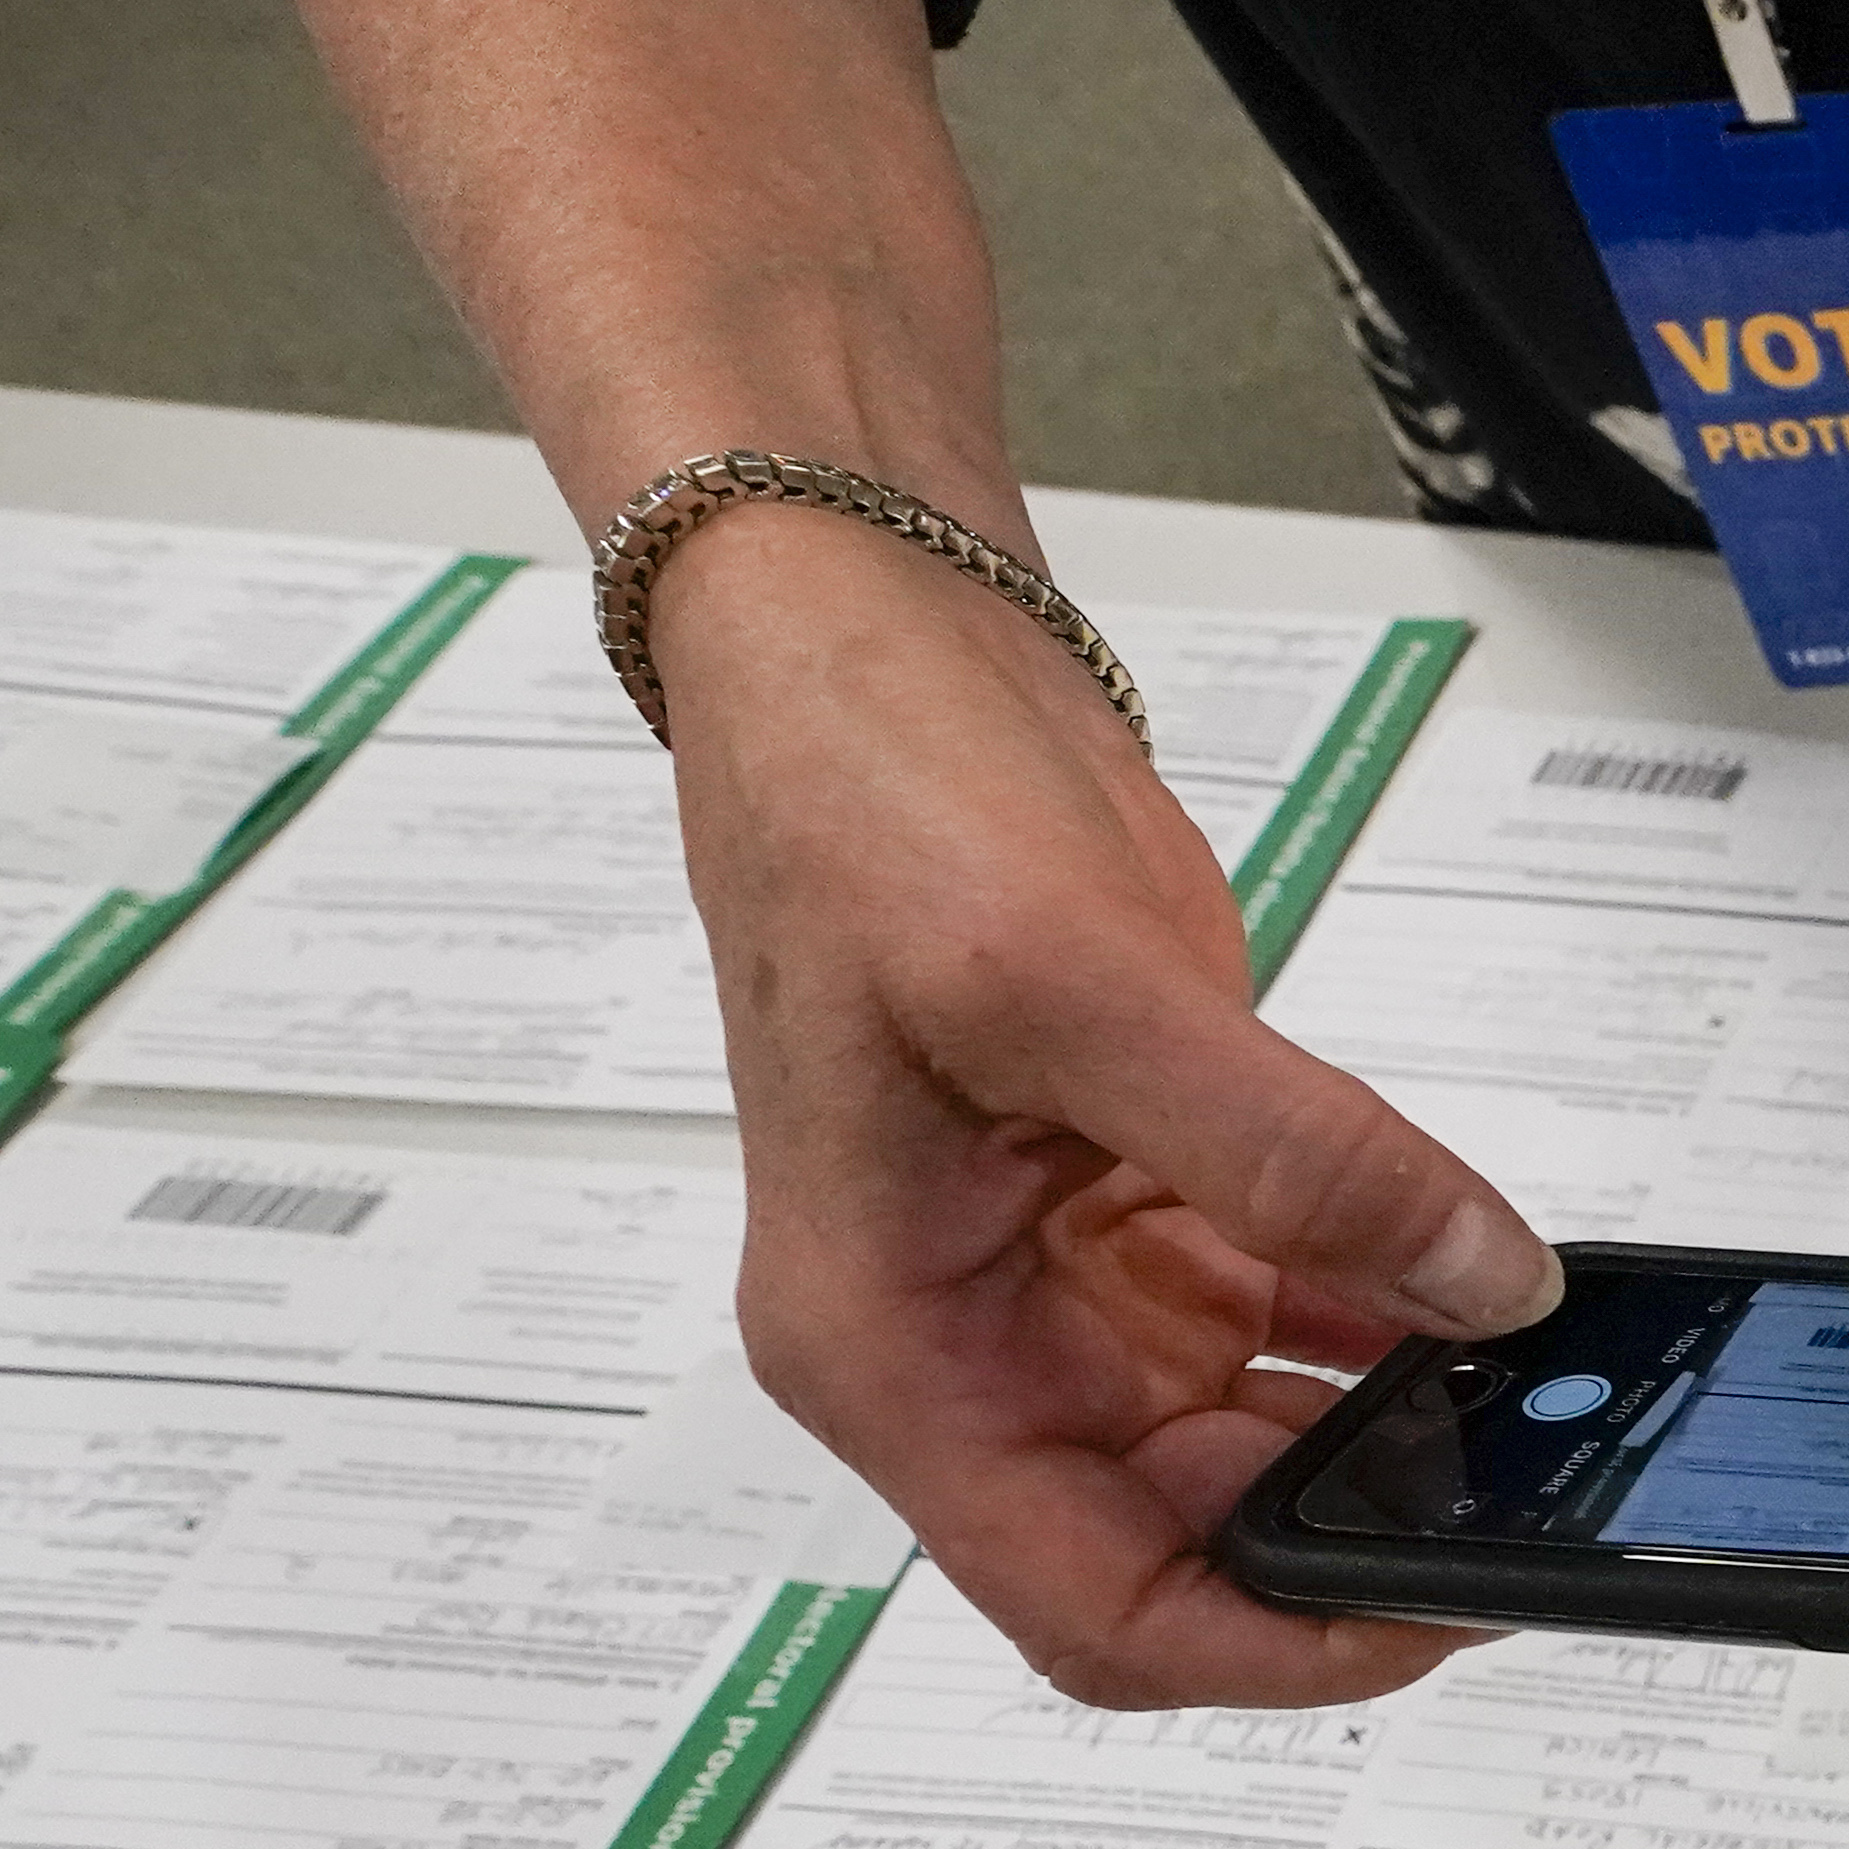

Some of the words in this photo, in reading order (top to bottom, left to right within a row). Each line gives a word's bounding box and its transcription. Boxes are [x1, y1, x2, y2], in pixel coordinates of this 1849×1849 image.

[1661, 1327, 1706, 1364] VIDEO
[1606, 1379, 1657, 1424] PHOTO
[1539, 1440, 1602, 1495] SQUARE
[746, 1583, 847, 1708] lectoral
